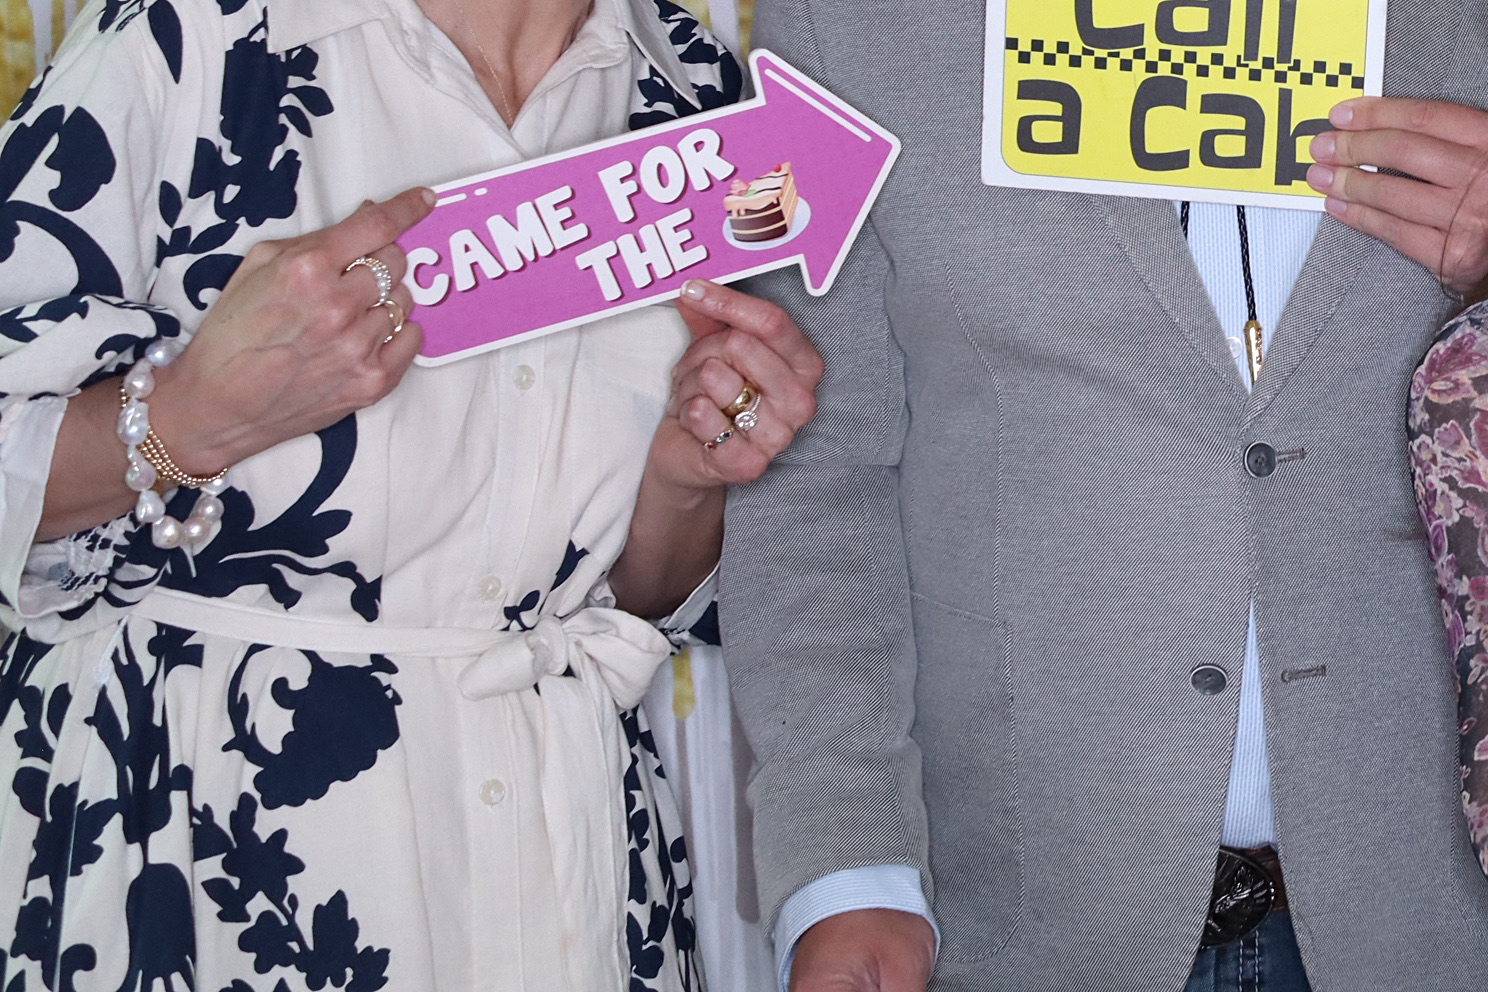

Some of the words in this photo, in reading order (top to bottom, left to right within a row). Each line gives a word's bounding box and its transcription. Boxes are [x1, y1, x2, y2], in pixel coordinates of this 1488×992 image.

[1016, 79, 1082, 155] a
[1129, 75, 1336, 186] Cab
[403, 185, 589, 306] CAME
[598, 128, 735, 223] FOR
[575, 208, 707, 302] THE
